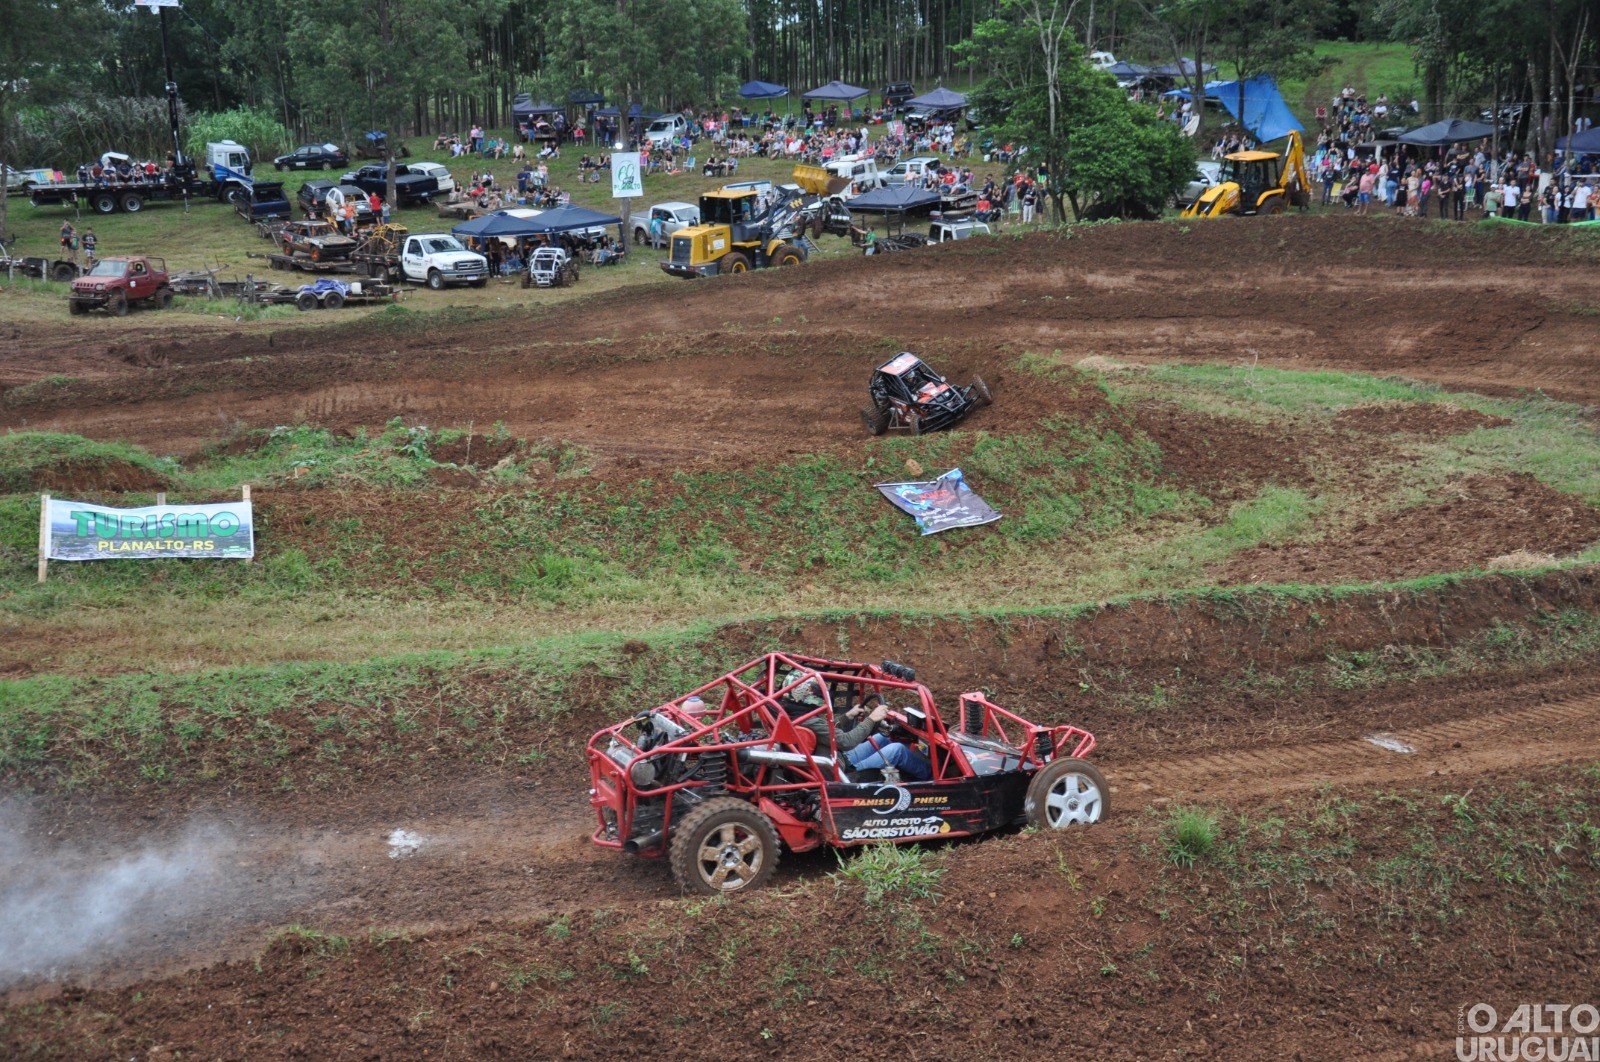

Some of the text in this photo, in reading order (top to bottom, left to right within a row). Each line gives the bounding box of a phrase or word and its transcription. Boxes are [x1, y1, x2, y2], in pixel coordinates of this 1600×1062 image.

[70, 510, 240, 538] TURISMO
[98, 540, 215, 552] PLANALTO-RS
[890, 818, 921, 826] POSTO
